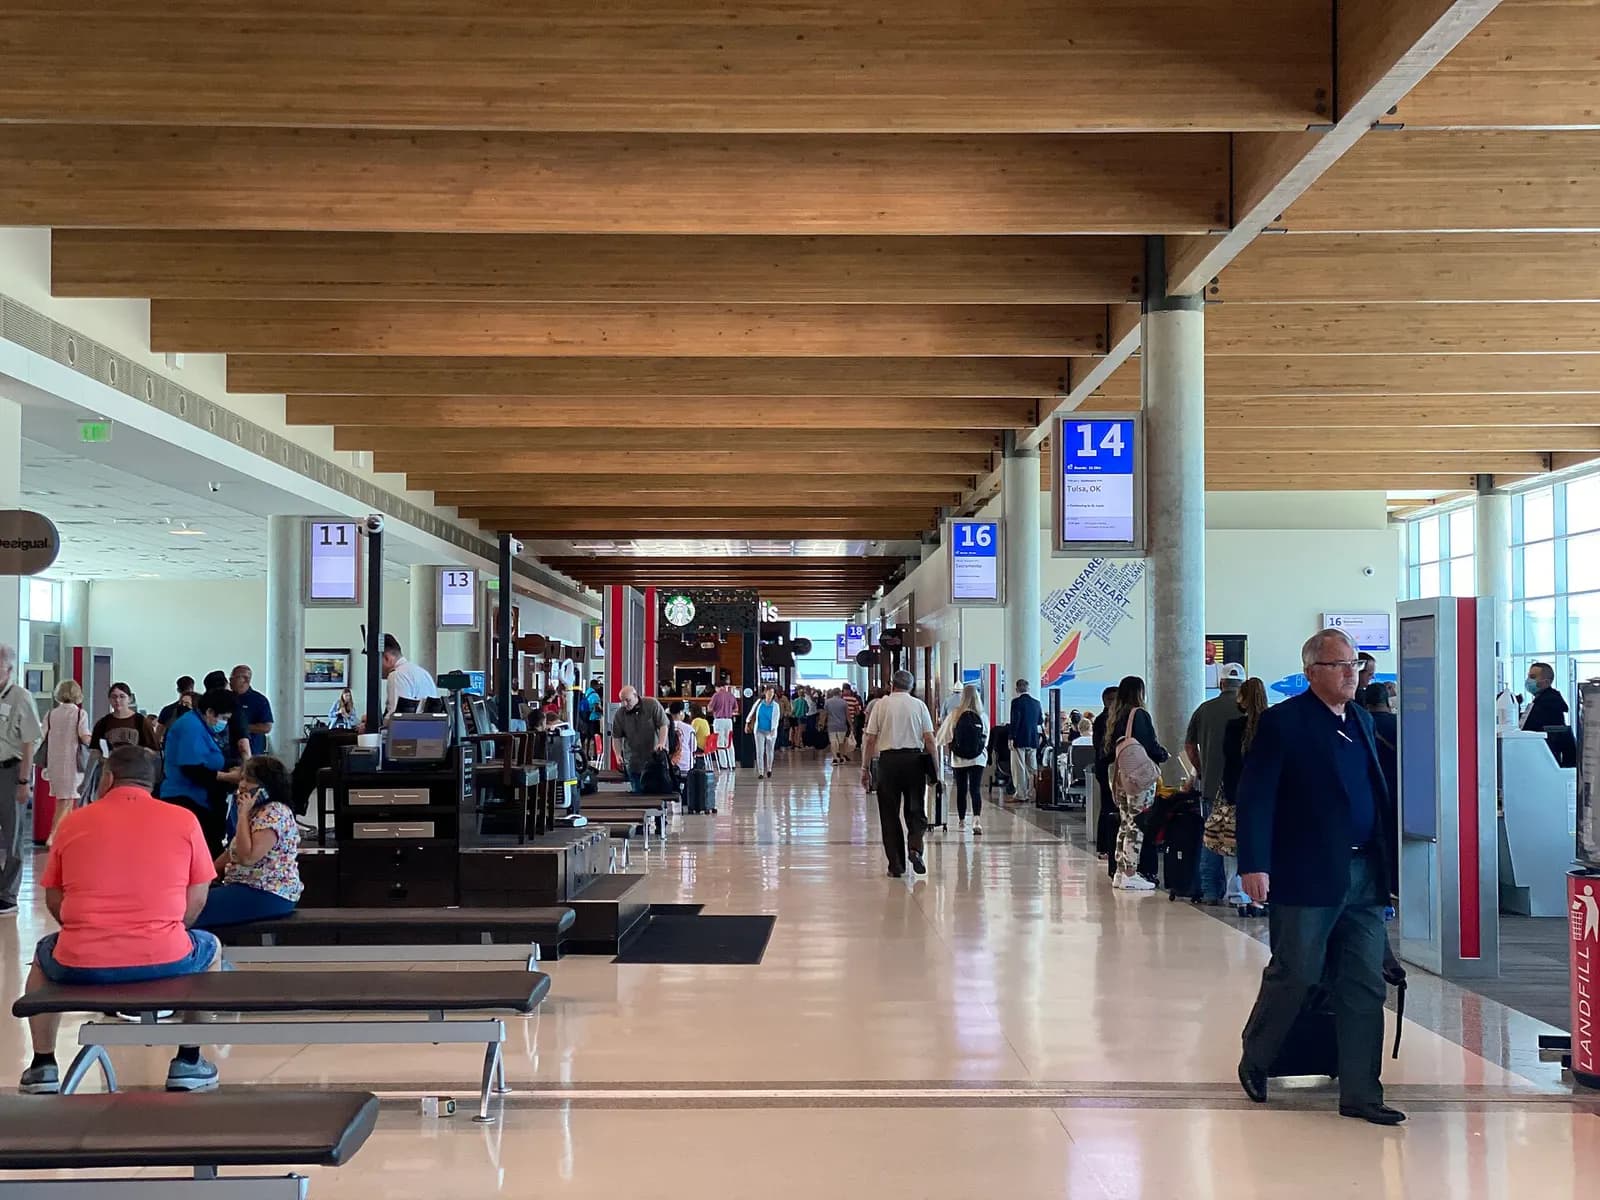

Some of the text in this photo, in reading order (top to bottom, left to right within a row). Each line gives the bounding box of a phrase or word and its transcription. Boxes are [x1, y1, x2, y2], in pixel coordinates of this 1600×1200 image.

[1076, 423, 1125, 457] 14
[1067, 485, 1102, 493] Tulsa, OK
[320, 525, 349, 546] 11
[961, 525, 991, 547] 16
[0, 537, 48, 551] esigual
[448, 572, 469, 587] 13
[1053, 557, 1105, 613] TRANSFARE
[1080, 586, 1093, 601] WE
[1087, 591, 1099, 606] FLY
[1094, 577, 1130, 608] HEART
[1092, 597, 1105, 611] FOR
[1098, 600, 1111, 614] YOU
[1053, 622, 1065, 634] BIG
[1062, 601, 1081, 623] HEART
[1053, 623, 1072, 645] LITTLE
[1069, 605, 1087, 625] FARES
[1329, 617, 1342, 626] 16
[850, 626, 863, 636] 18
[1577, 946, 1593, 1071] LANDFILL
